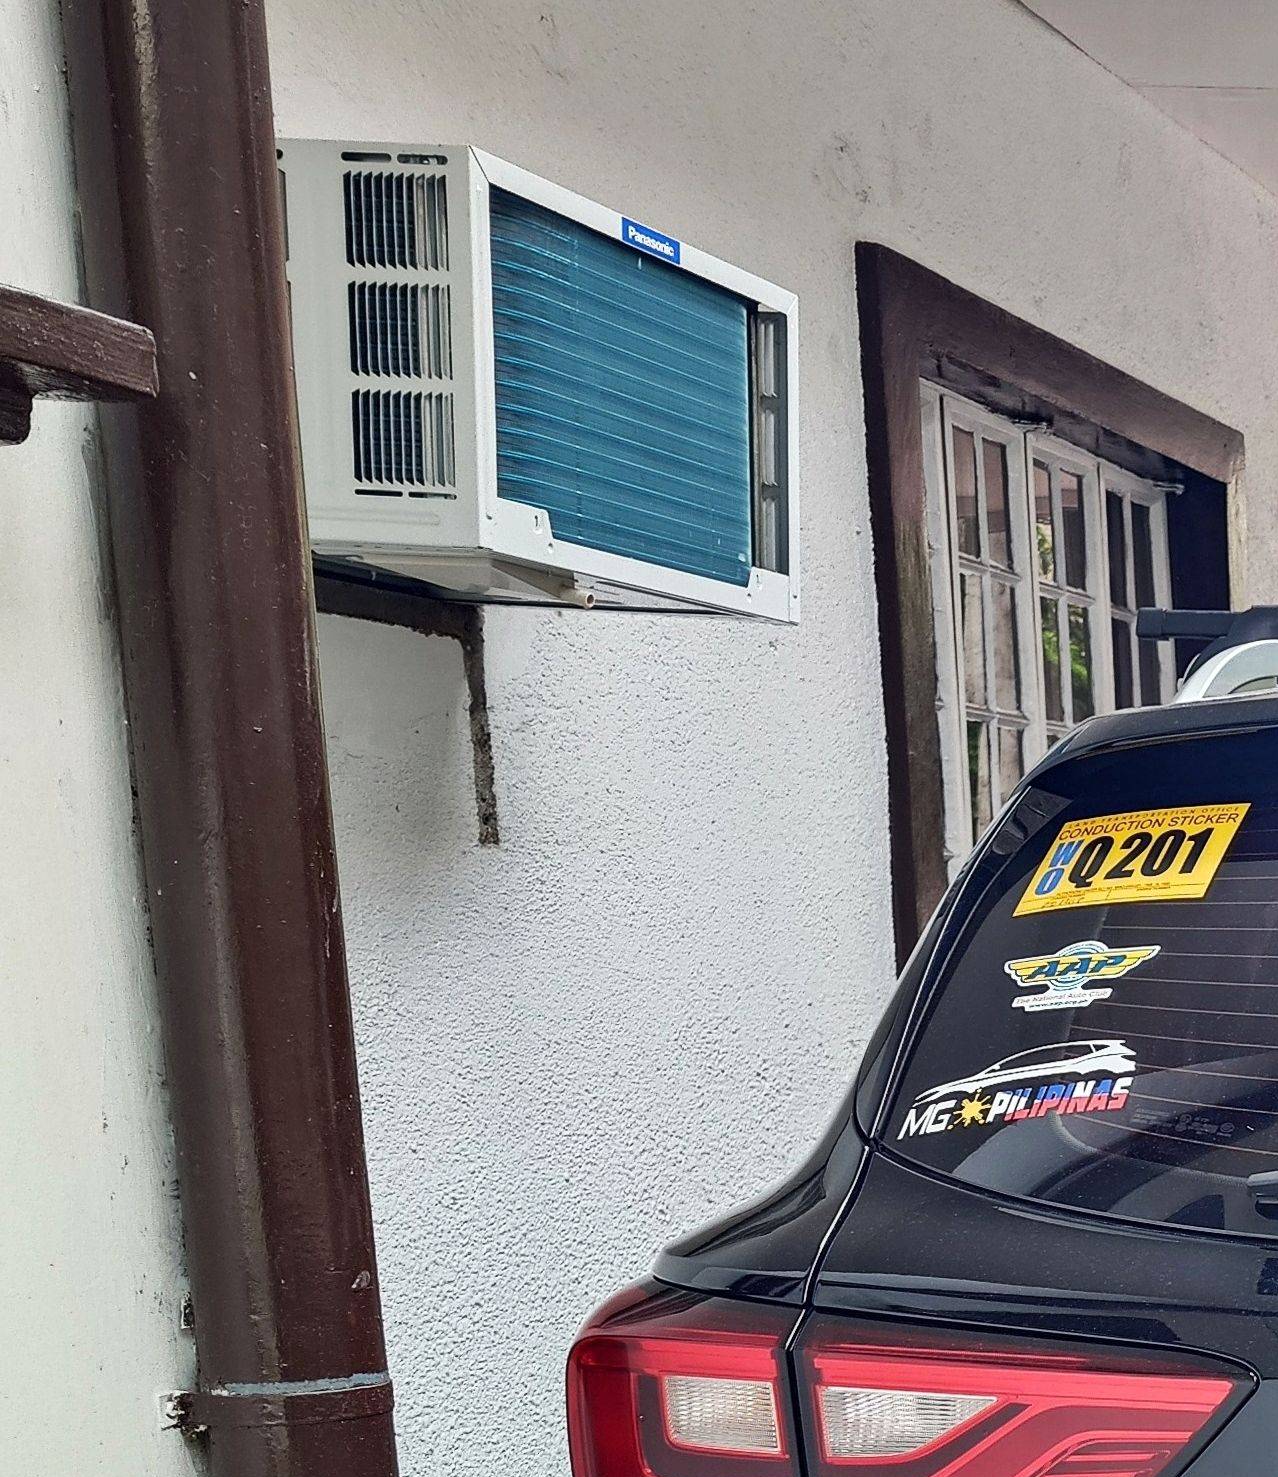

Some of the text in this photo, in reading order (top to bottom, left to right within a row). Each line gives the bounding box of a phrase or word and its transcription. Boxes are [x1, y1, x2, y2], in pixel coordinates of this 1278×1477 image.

[627, 225, 675, 258] Panasonic
[1058, 812, 1240, 841] CONDUCTION STICKER
[1068, 827, 1215, 889] Q201
[1023, 954, 1127, 981] AAP
[896, 1098, 957, 1141] MG
[985, 1076, 1135, 1124] PILIPINAS
